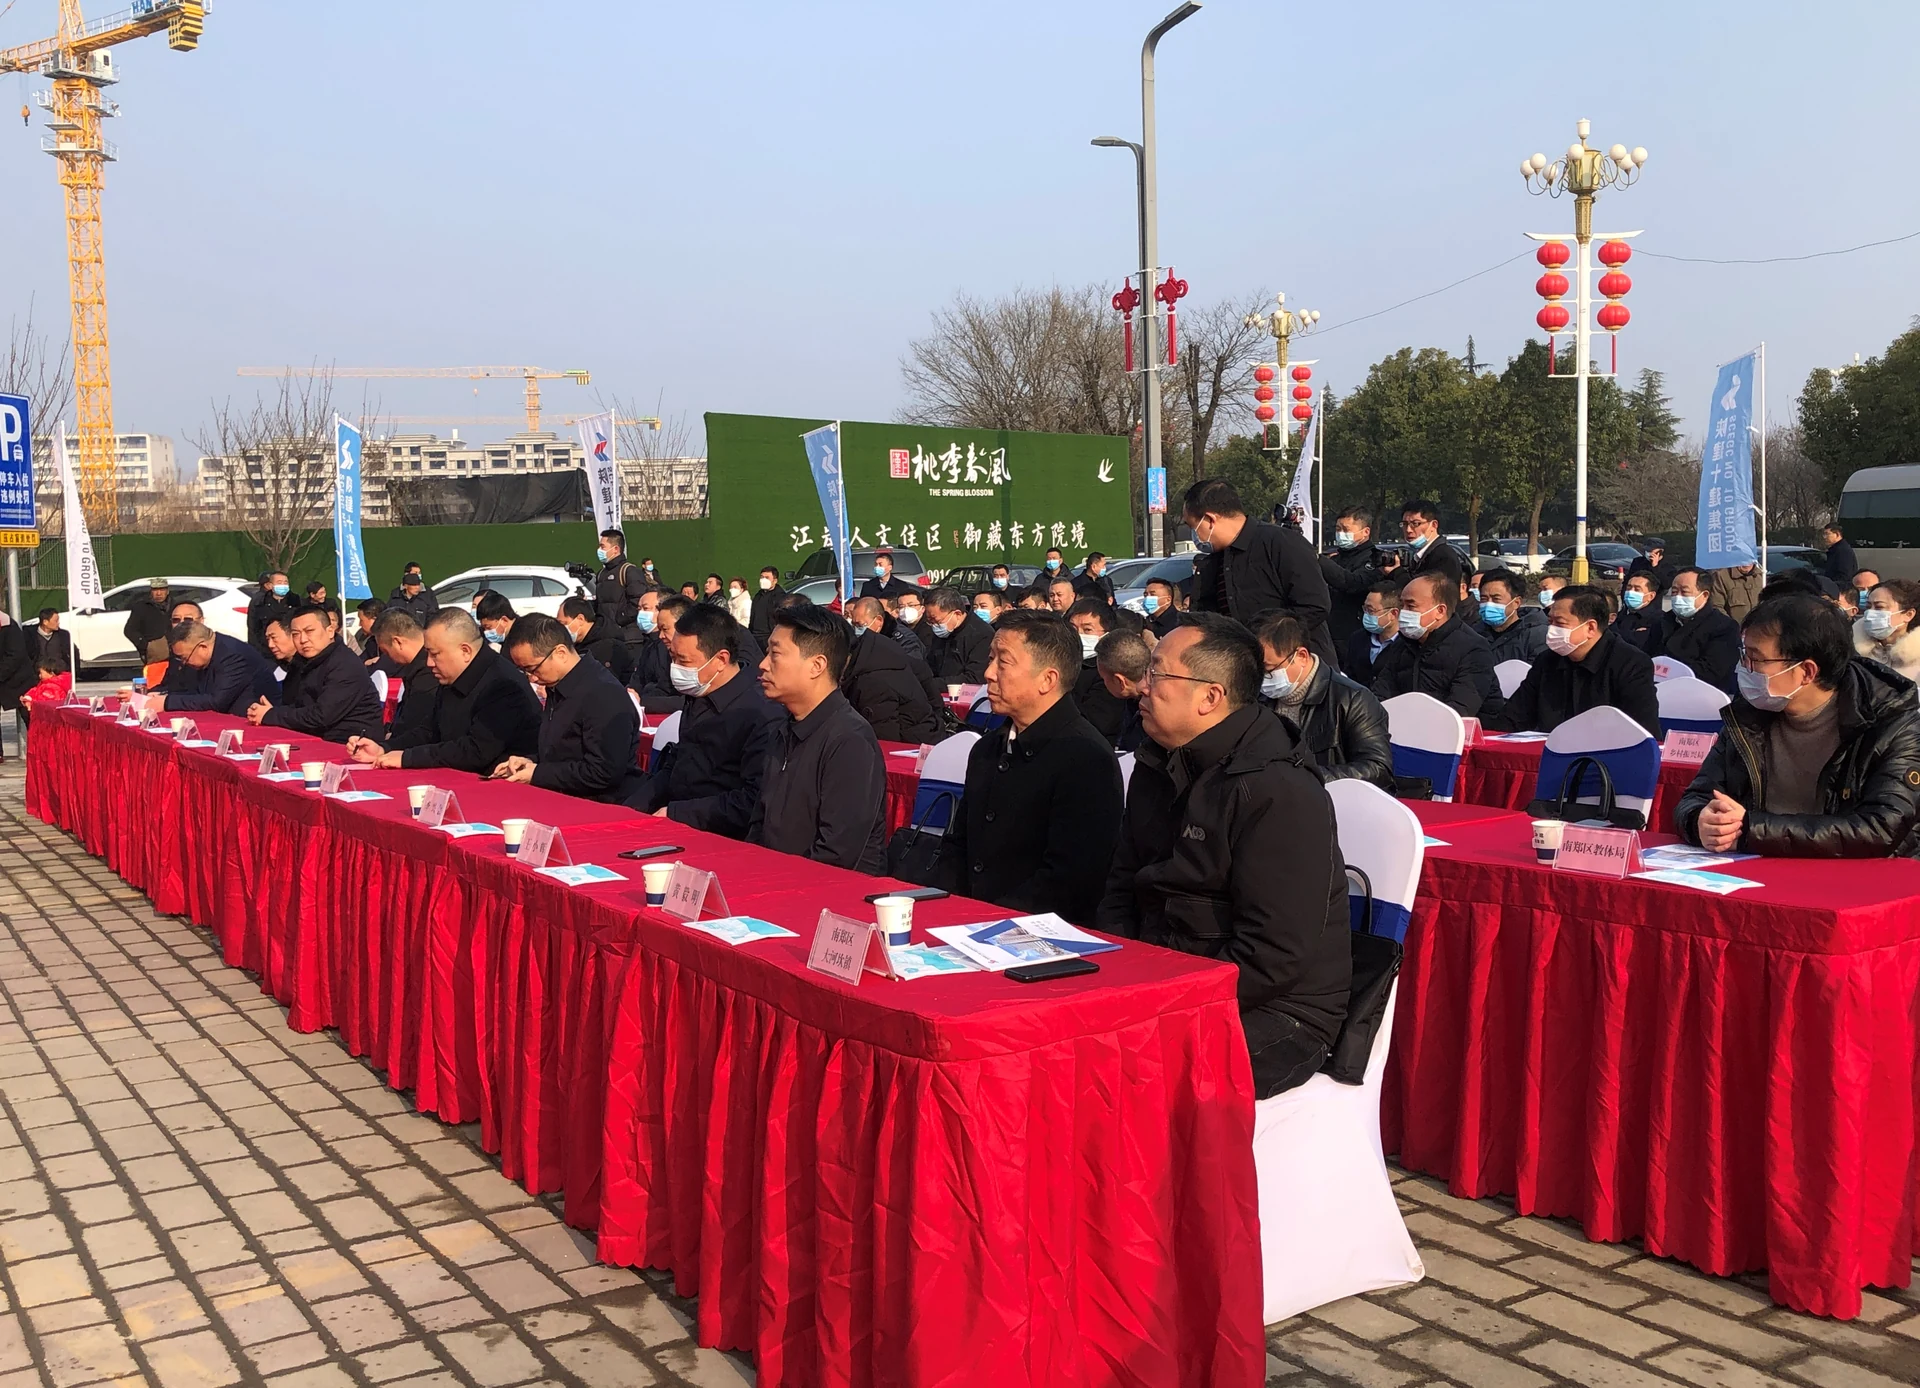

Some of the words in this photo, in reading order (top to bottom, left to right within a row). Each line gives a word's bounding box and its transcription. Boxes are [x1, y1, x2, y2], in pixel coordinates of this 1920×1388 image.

[0, 404, 21, 461] P
[929, 488, 941, 497] THE
[942, 488, 964, 497] SPRING
[965, 488, 994, 497] BLOSSOM
[81, 557, 91, 595] GROUP
[1561, 839, 1626, 860] 南郑区教体局
[831, 927, 855, 947] 南郑区
